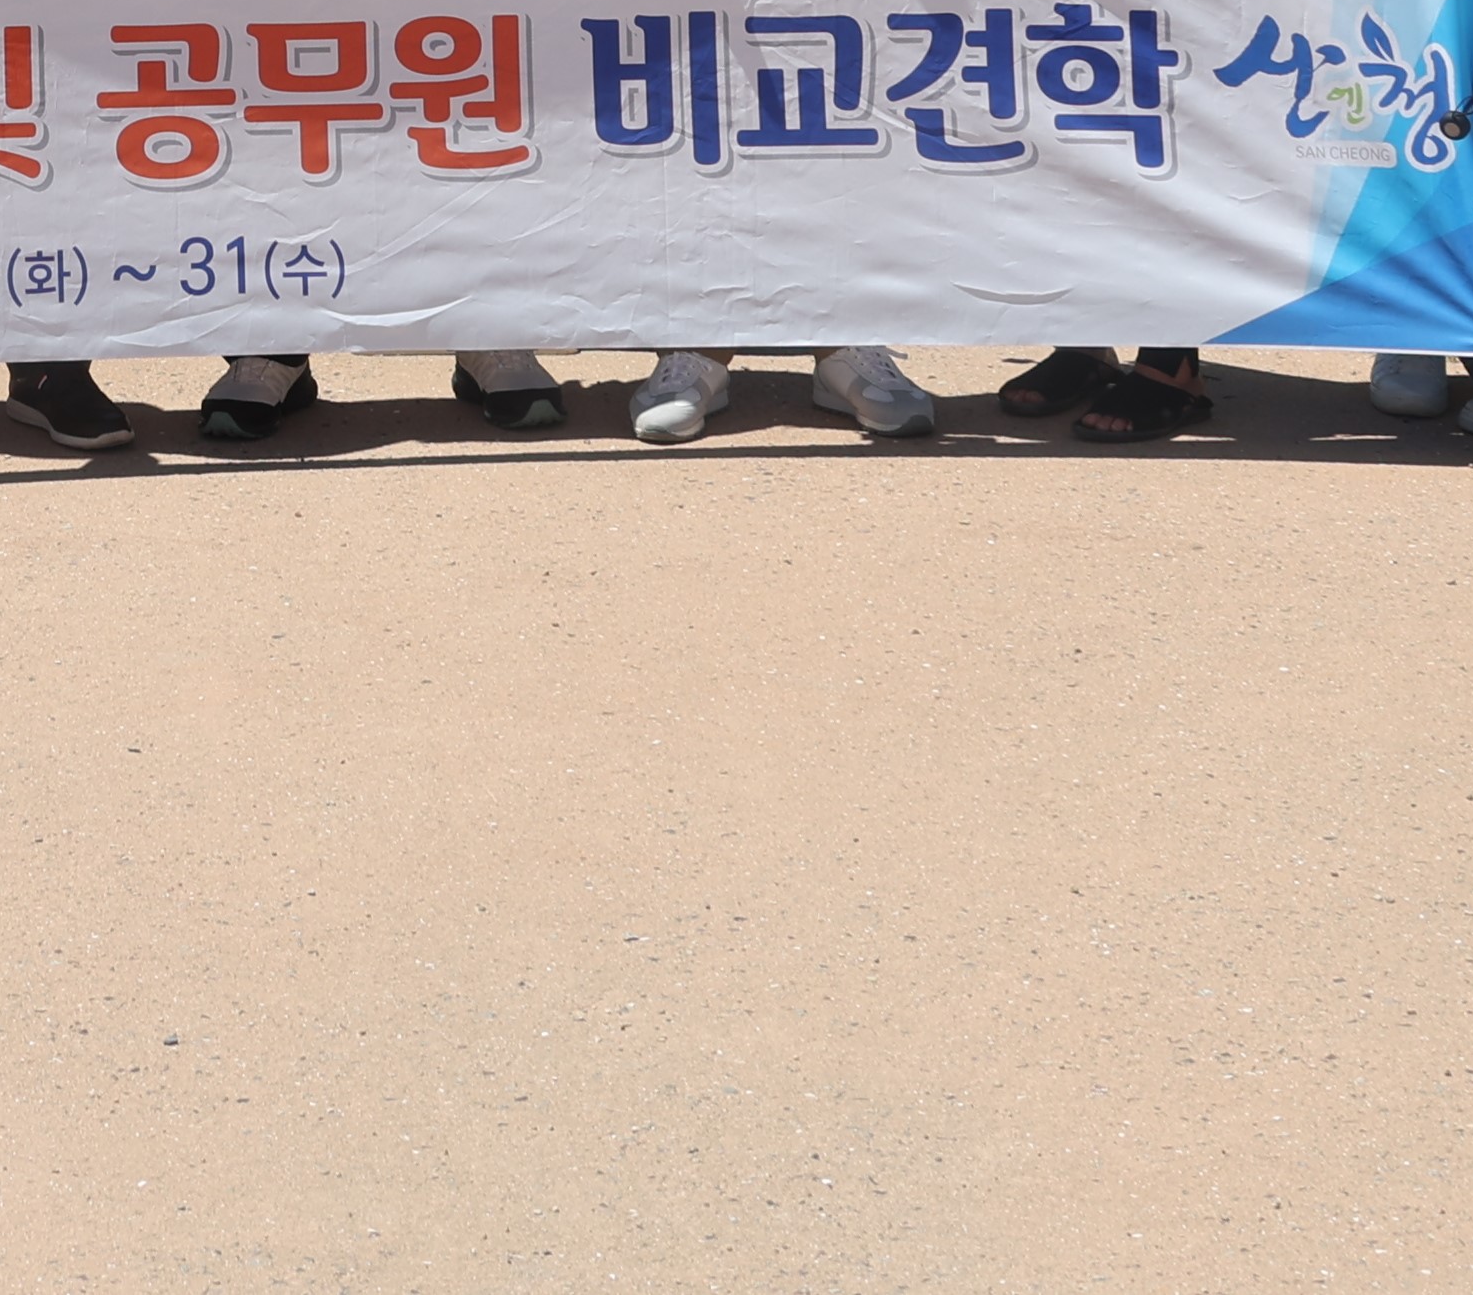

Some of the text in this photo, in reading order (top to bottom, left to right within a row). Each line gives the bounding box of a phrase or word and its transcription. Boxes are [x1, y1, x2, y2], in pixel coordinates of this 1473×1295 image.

[97, 14, 529, 180] 공무원
[582, 3, 1179, 169] 비교견학
[1295, 145, 1391, 161] SAN CHEONG
[179, 235, 346, 301] 31(수)
